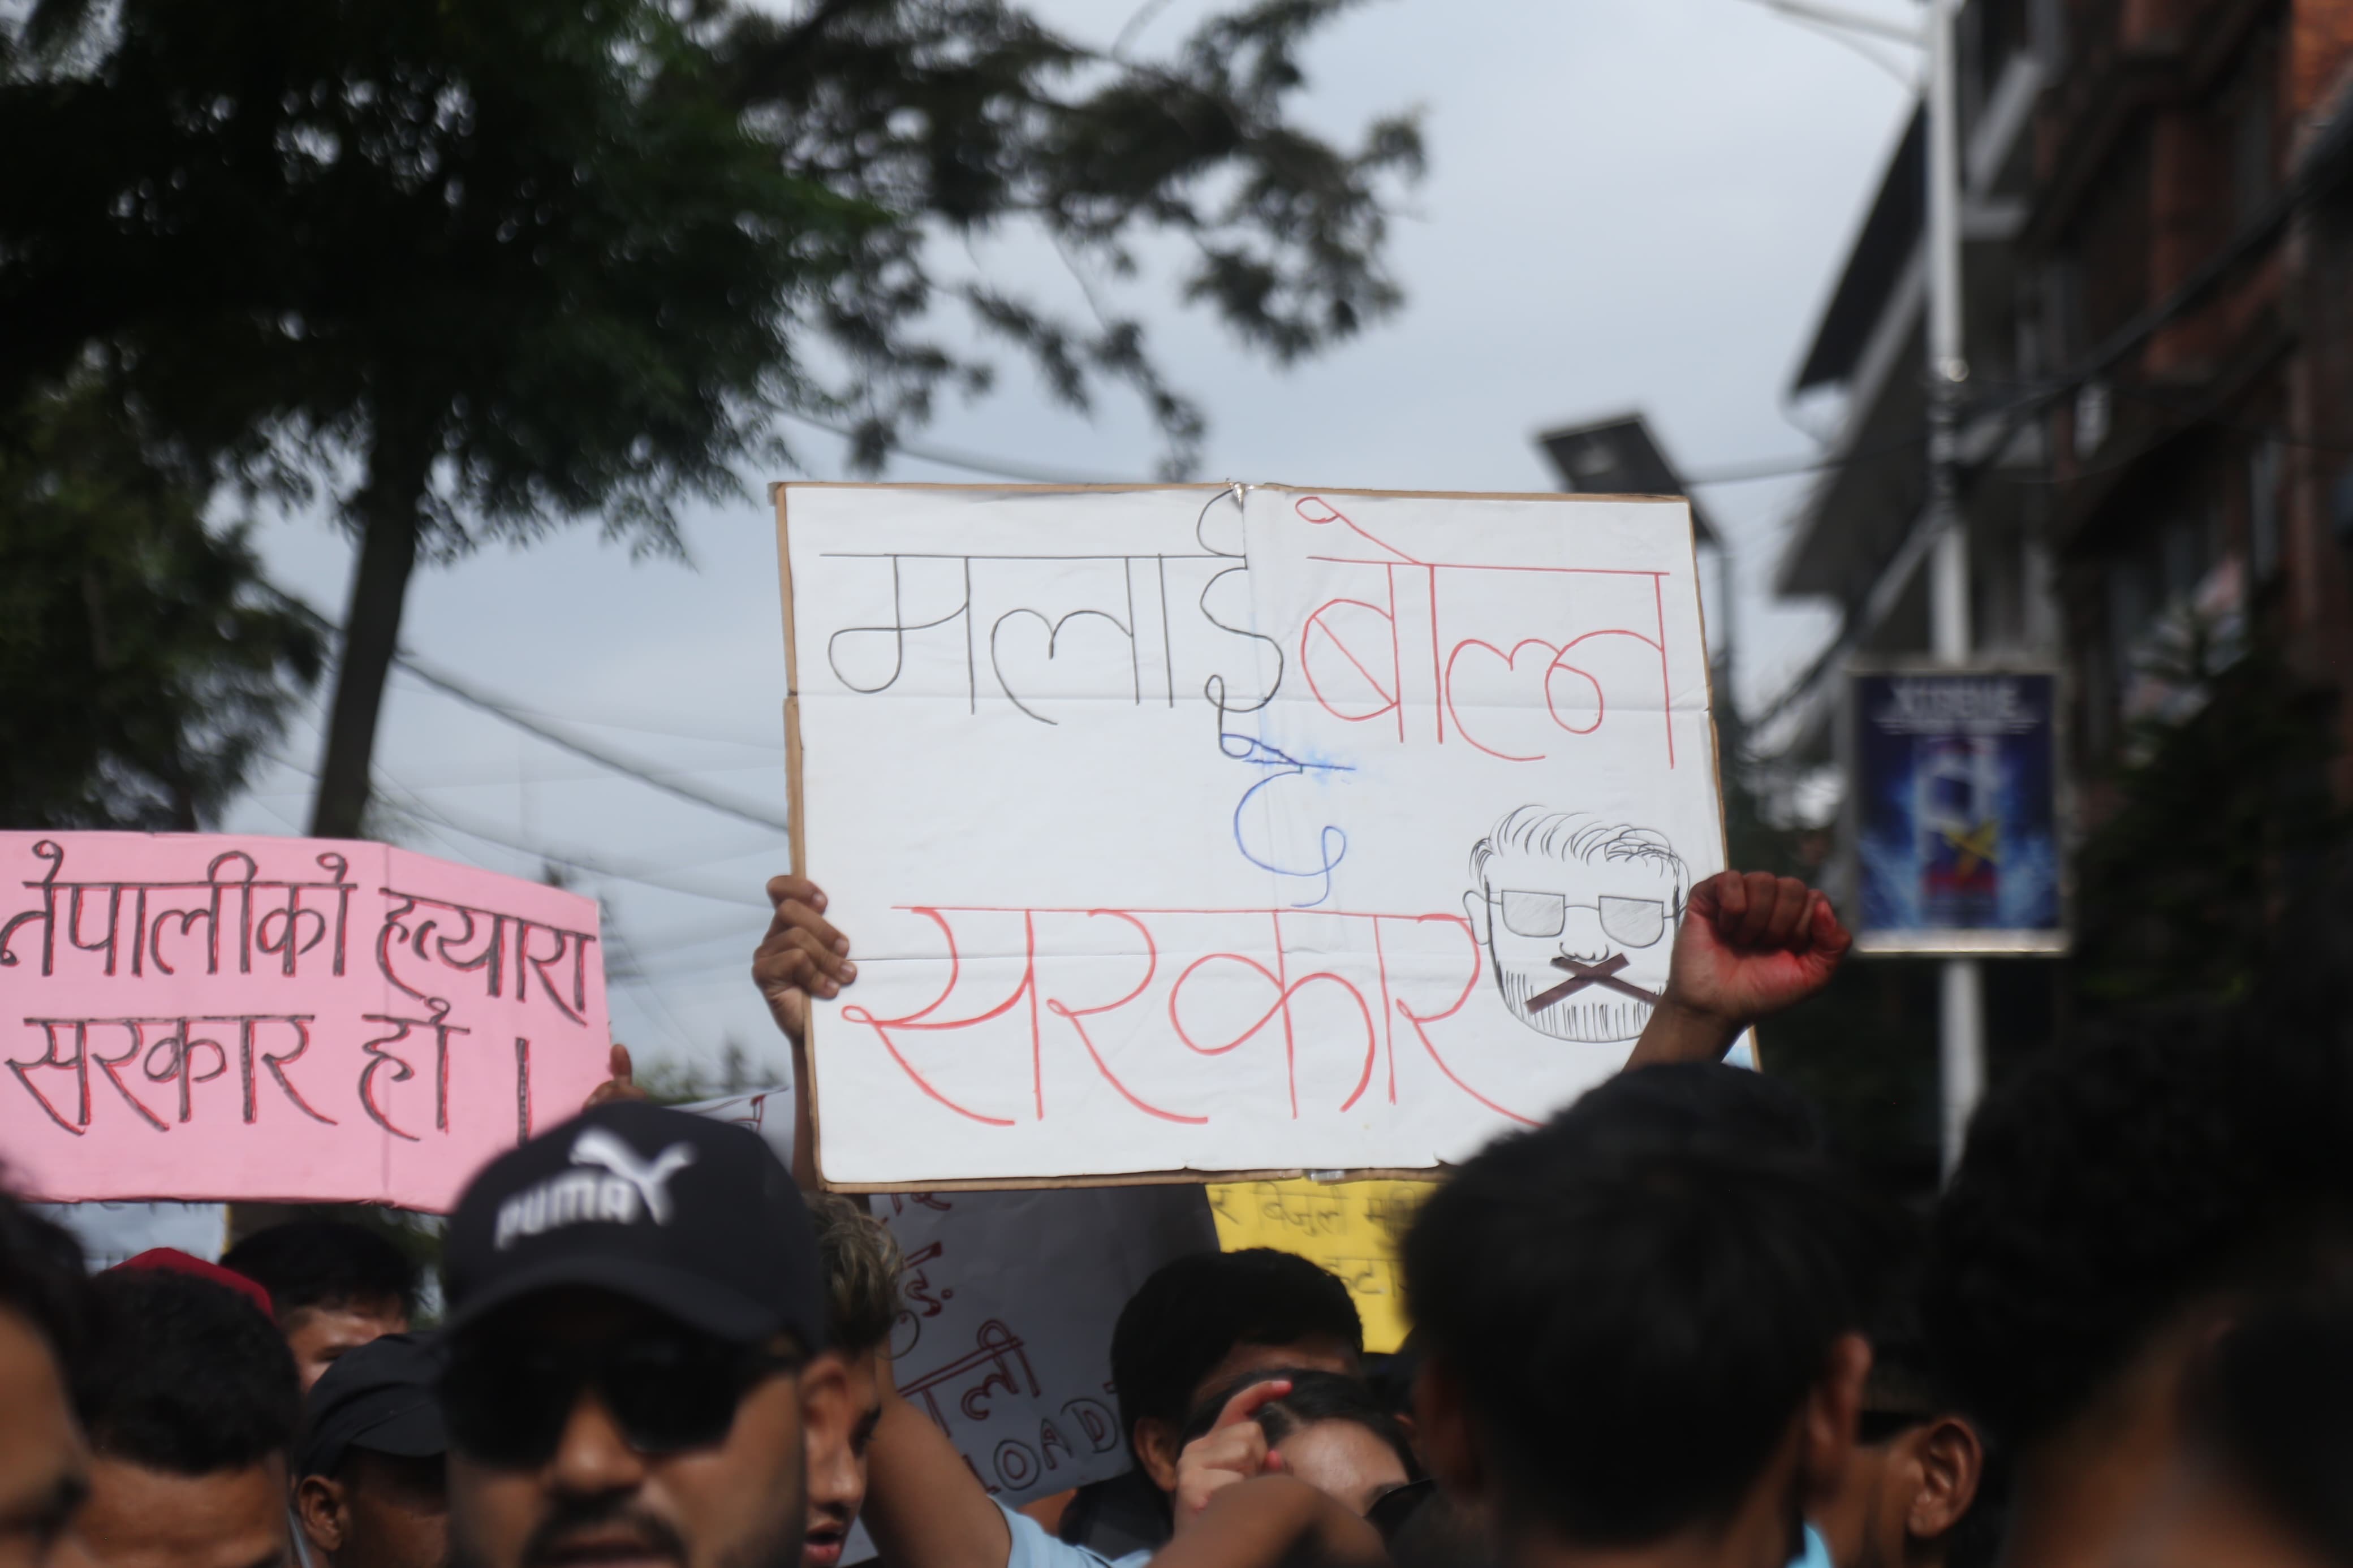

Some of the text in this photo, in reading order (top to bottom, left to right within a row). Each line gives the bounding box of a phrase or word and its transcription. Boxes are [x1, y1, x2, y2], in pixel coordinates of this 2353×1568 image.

[820, 487, 1284, 758] मलाई
[376, 886, 597, 1026] हत्यारा
[841, 905, 1551, 1129] सरकार
[5, 1014, 338, 1136] सरकार
[357, 996, 471, 1142] हो
[494, 1168, 637, 1251] PUMA
